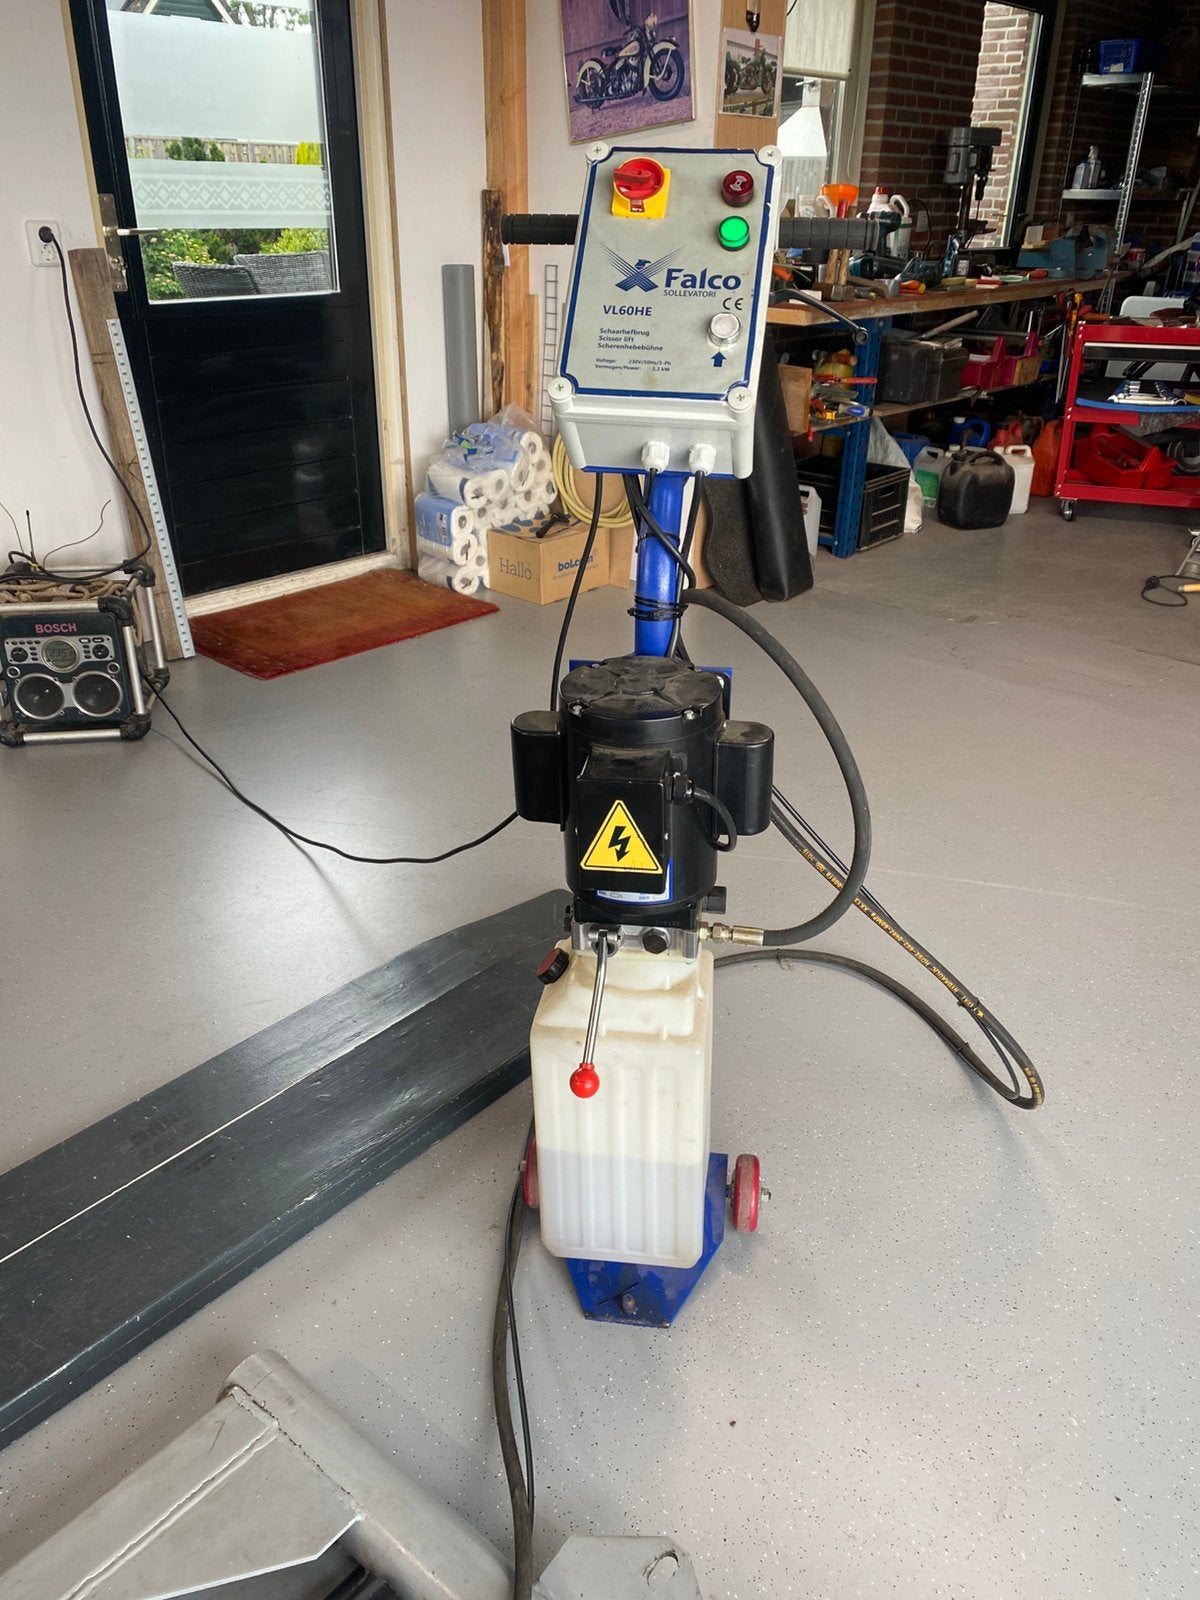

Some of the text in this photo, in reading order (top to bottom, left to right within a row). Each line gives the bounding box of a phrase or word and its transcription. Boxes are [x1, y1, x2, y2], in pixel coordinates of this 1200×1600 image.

[665, 267, 741, 290] Falco
[663, 289, 717, 298] SOLLEVATORI
[722, 297, 744, 311] CE
[603, 304, 652, 317] VL60HE
[599, 327, 650, 337] Schaarhefbrug
[598, 335, 623, 343] Scissor
[597, 342, 664, 351] Scherenhebebühne
[499, 557, 533, 580] Hallo
[34, 622, 78, 634] BOSCH
